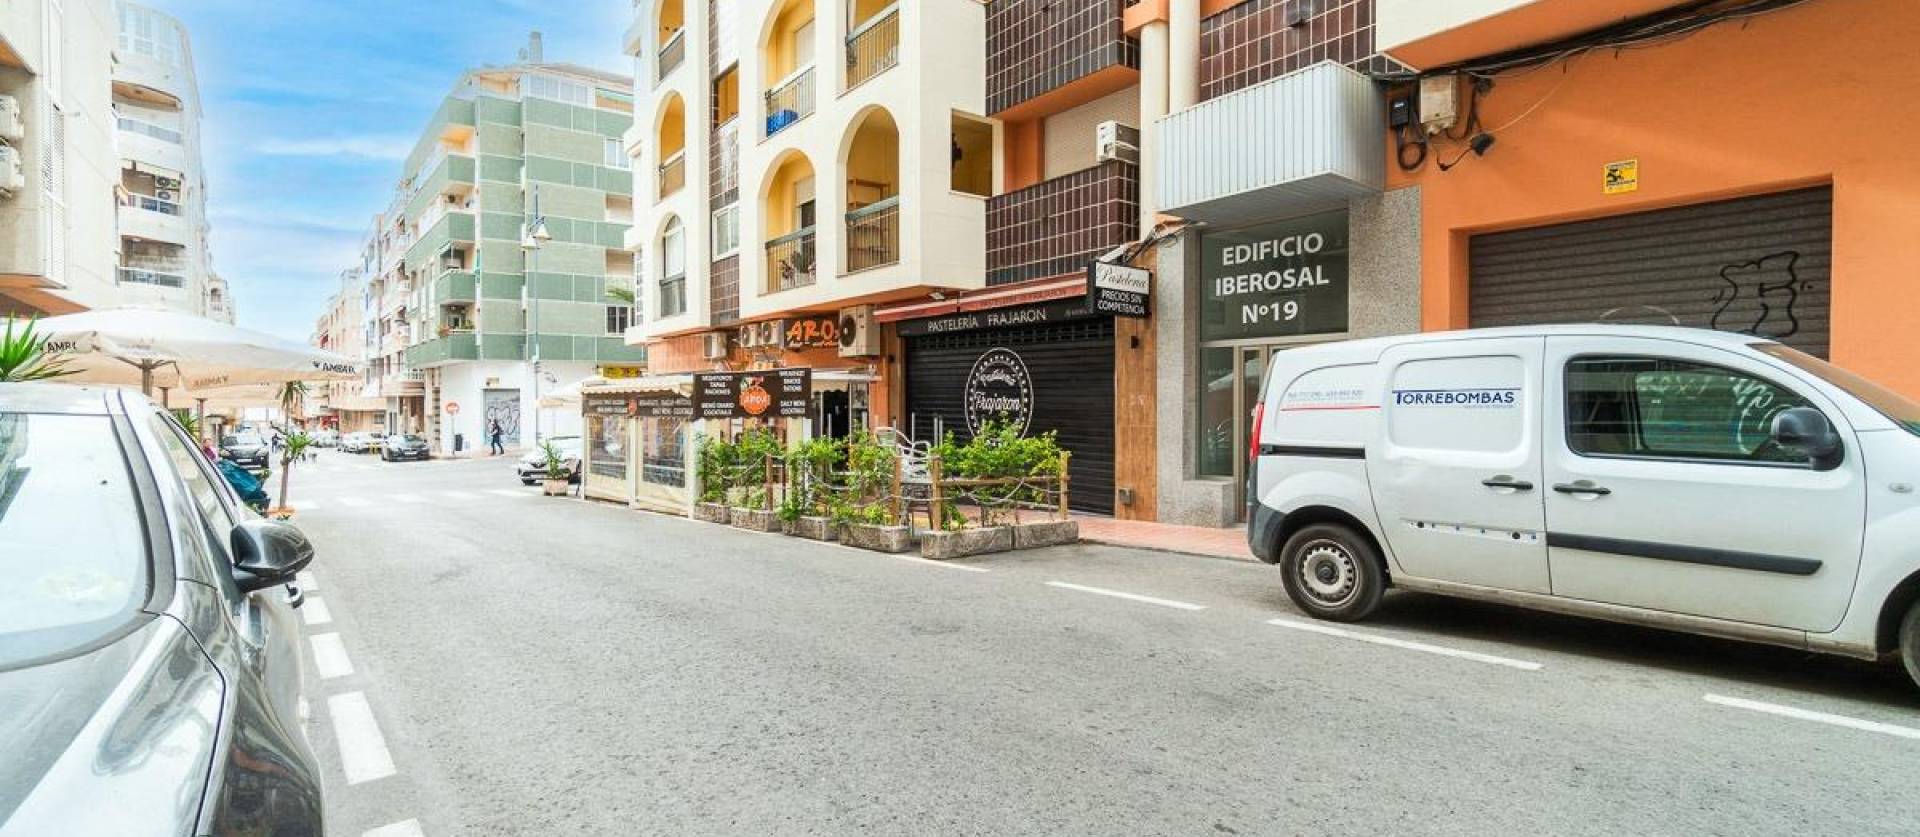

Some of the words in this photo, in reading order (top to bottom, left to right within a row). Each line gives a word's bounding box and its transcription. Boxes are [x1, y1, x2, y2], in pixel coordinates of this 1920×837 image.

[1223, 233, 1323, 266] EDIFICIO
[1215, 265, 1330, 296] IBEROSAL
[1098, 300, 1145, 315] COMPETENCIA
[1102, 289, 1130, 303] PRECIOS
[927, 314, 979, 332] PASTELERÍA
[988, 308, 1046, 326] FRAJARON
[975, 391, 1021, 415] Frajaron
[1393, 389, 1516, 406] TORREBOMBAS
